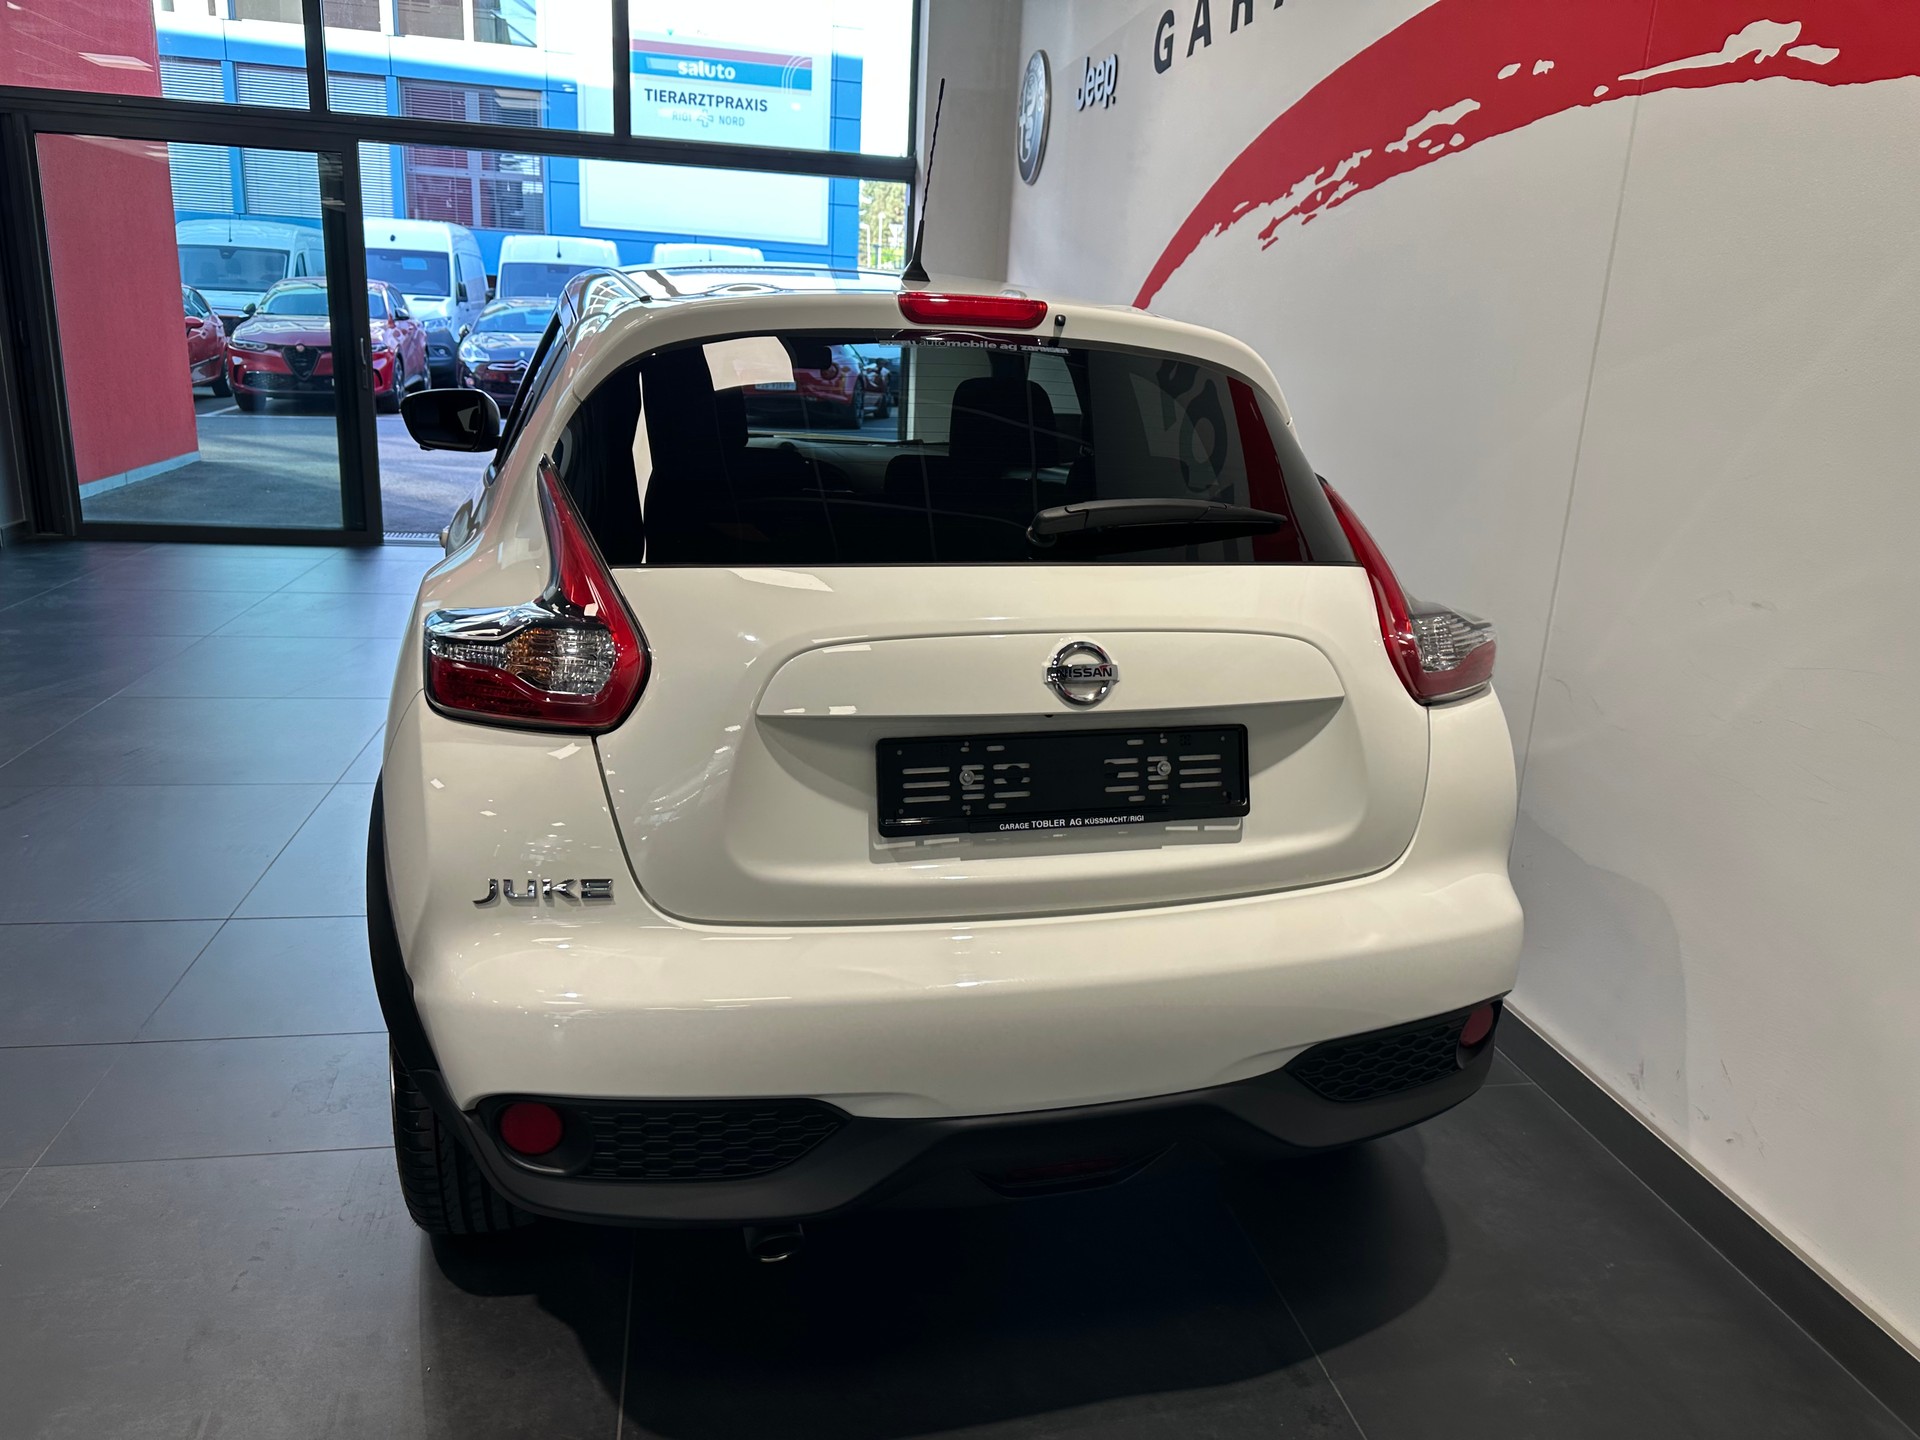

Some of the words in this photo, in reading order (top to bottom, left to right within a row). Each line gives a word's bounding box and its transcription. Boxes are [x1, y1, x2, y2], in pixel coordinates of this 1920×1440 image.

[677, 60, 736, 80] saluto
[1077, 53, 1118, 111] Jeep
[644, 88, 768, 112] TIERARZTPRAXIS
[719, 115, 745, 127] NORD
[919, 339, 997, 350] automobile
[1000, 344, 1017, 352] ag
[1057, 668, 1112, 678] NISSAN
[999, 822, 1030, 830] GARAGE
[1031, 819, 1066, 828] TOBLER
[1069, 818, 1082, 826] AG
[473, 879, 614, 904] JUKE
